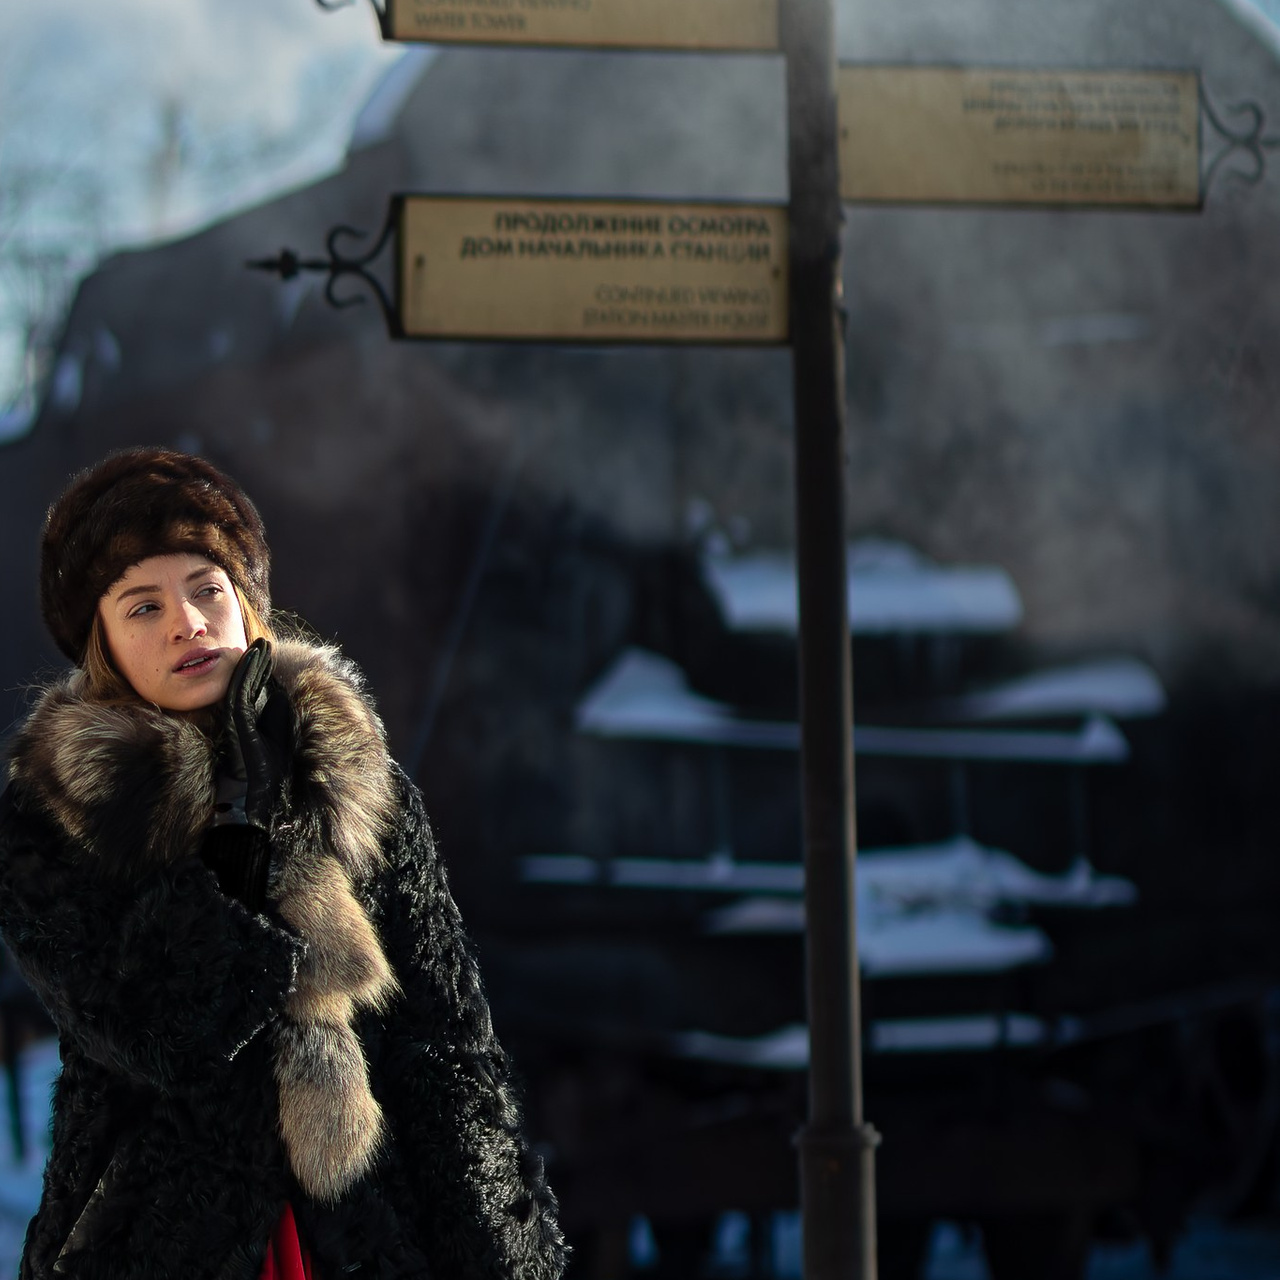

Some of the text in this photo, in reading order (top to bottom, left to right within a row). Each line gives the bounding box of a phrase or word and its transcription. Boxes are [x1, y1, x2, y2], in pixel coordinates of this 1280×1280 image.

[494, 212, 772, 237] ПРОДОЛЖЕНИЕ ОСМОТРА
[460, 236, 771, 264] ДОМ НАЧАЛЬНИКА СТАНЦИИ
